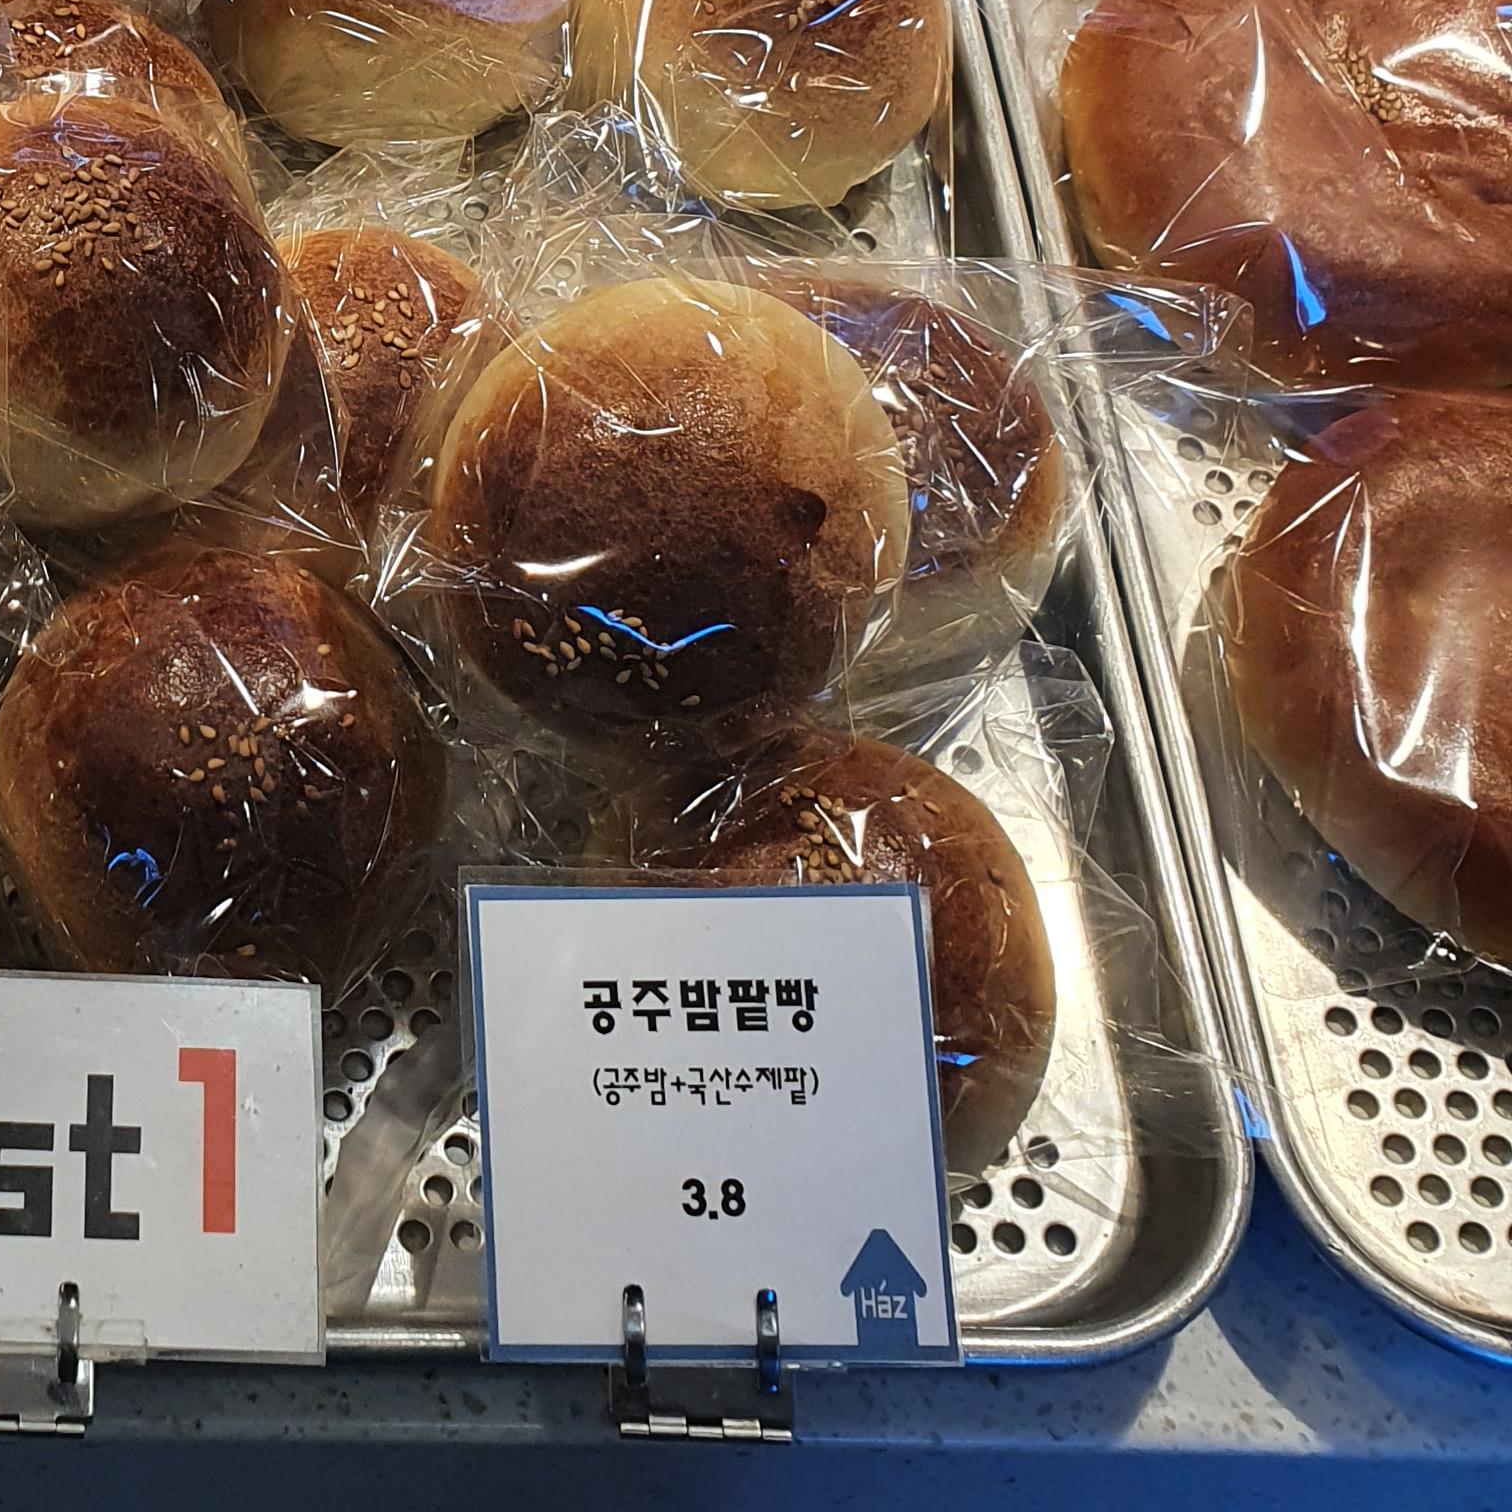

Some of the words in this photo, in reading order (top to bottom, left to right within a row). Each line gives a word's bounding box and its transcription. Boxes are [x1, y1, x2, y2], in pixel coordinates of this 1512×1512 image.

[582, 976, 820, 1035] 공주밤팥빵
[592, 1066, 820, 1107] (공주밤+국산수제팥)
[680, 1177, 747, 1221] 3.8
[860, 1278, 909, 1320] Ház
